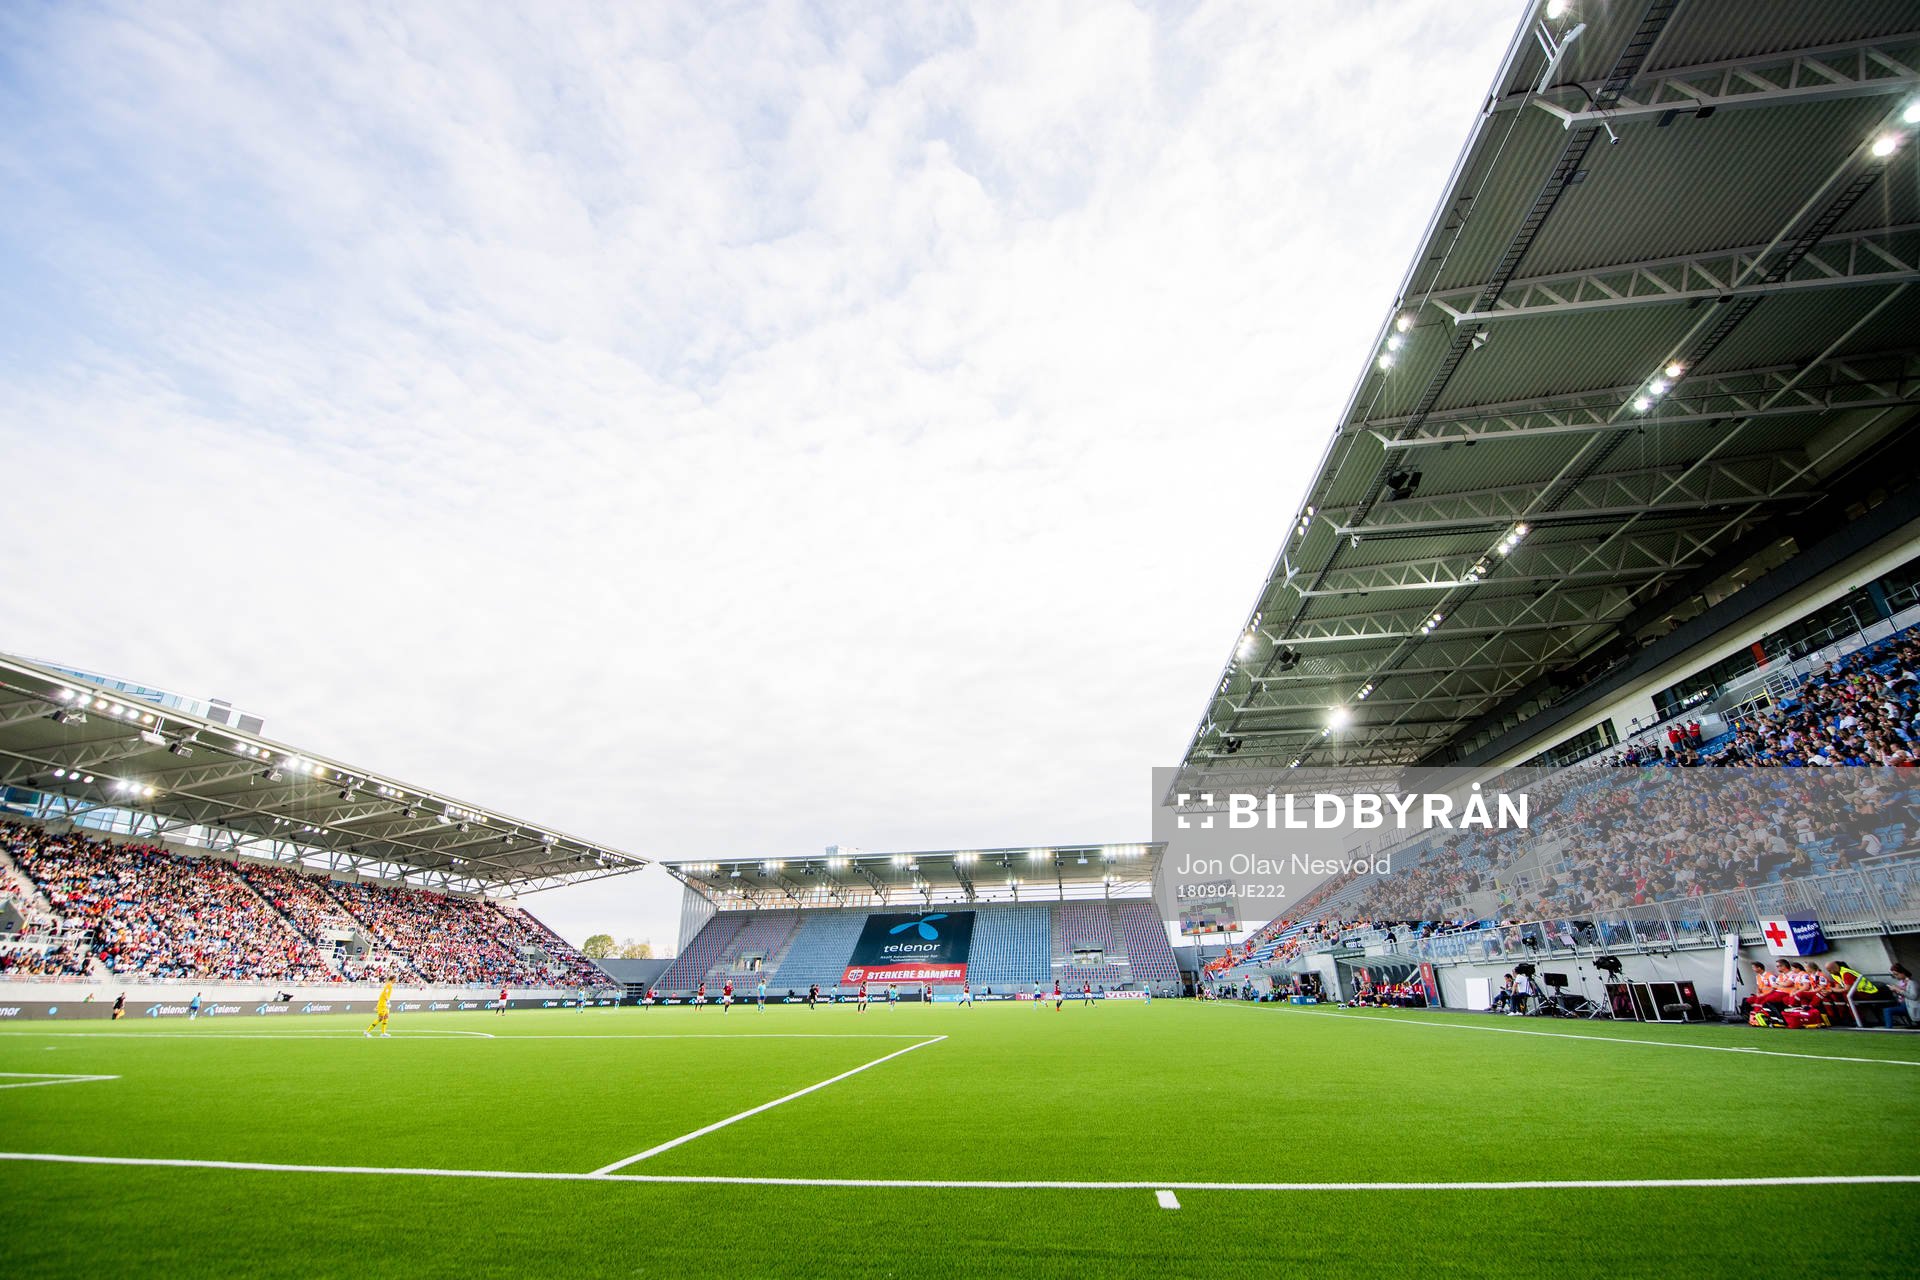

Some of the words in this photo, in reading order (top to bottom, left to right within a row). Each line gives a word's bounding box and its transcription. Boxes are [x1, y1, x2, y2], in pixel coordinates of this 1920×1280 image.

[884, 943, 940, 953] telenor
[867, 970, 916, 980] STERKERE
[917, 969, 960, 979] SAMMEN
[1020, 992, 1035, 1000] TIN
[160, 1005, 188, 1014] telenor
[215, 1005, 241, 1013] telenor
